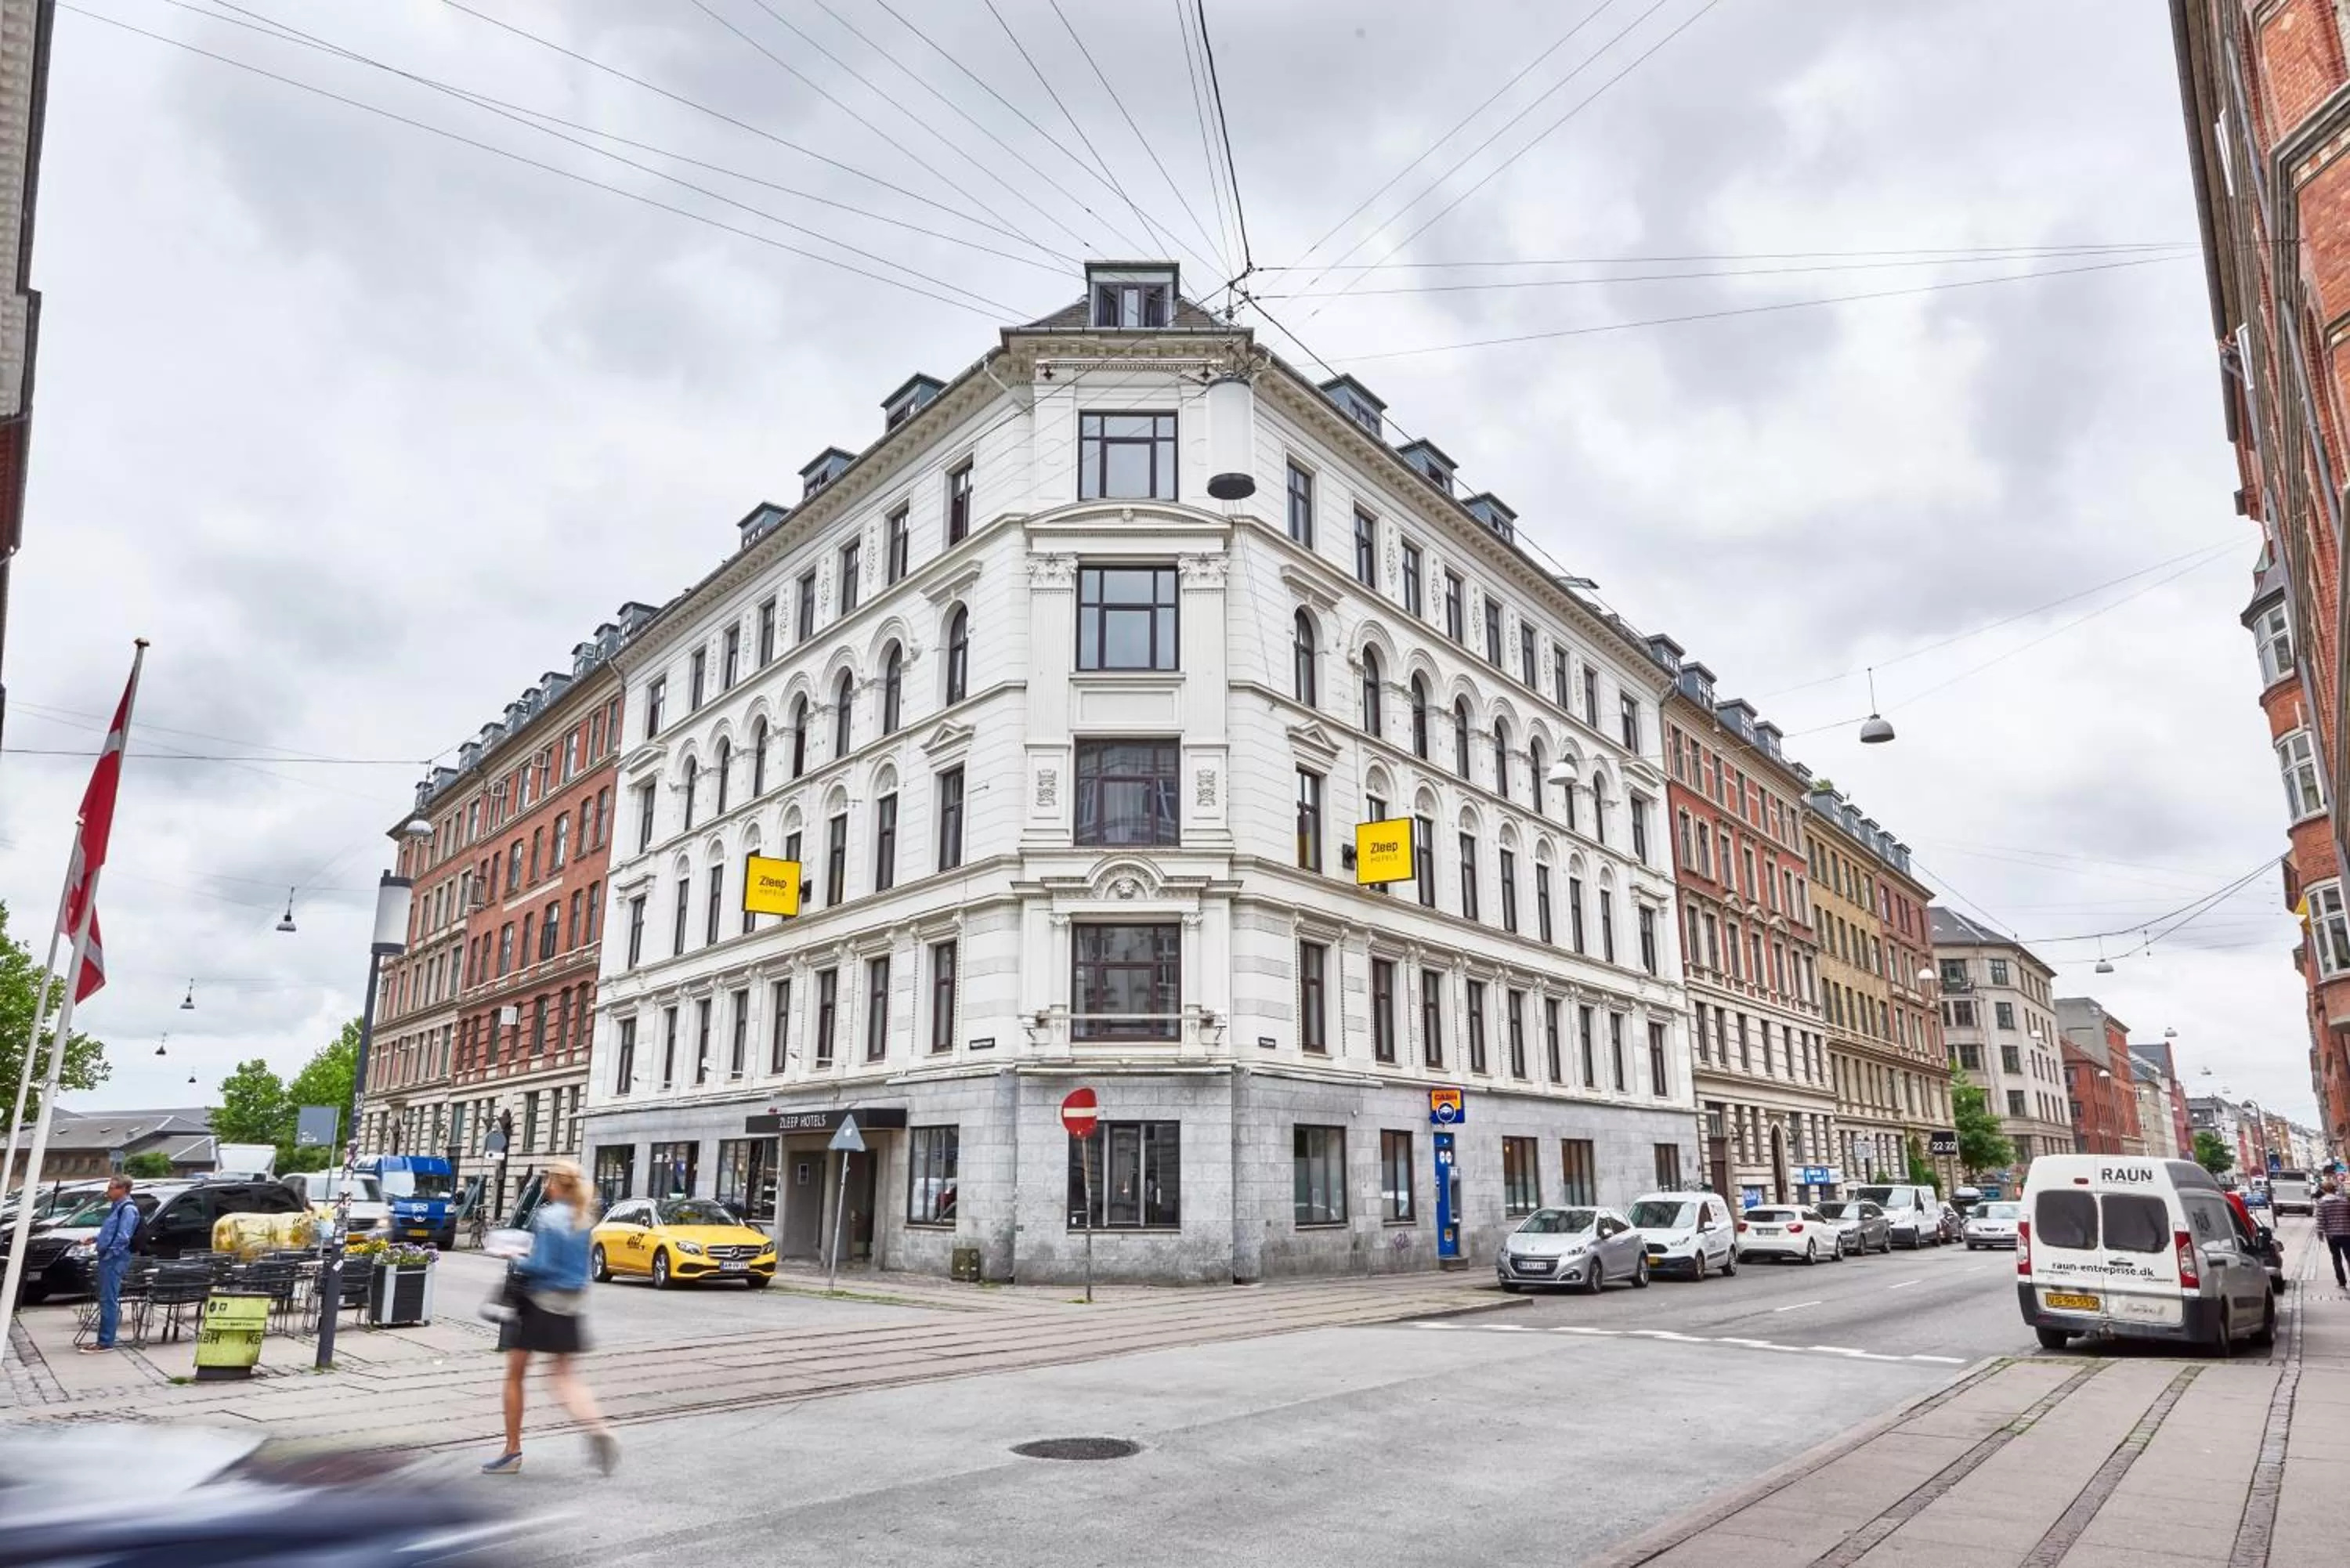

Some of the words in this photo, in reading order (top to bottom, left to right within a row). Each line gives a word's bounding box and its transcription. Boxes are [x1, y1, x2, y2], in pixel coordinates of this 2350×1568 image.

[1370, 840, 1398, 854] Zleep
[758, 875, 787, 890] Zleep
[779, 1115, 799, 1129] ZLEEP
[800, 1114, 826, 1128] HOTELS
[2101, 1168, 2153, 1182] RAUN
[2051, 1262, 2155, 1277] raun-entreprise.dk
